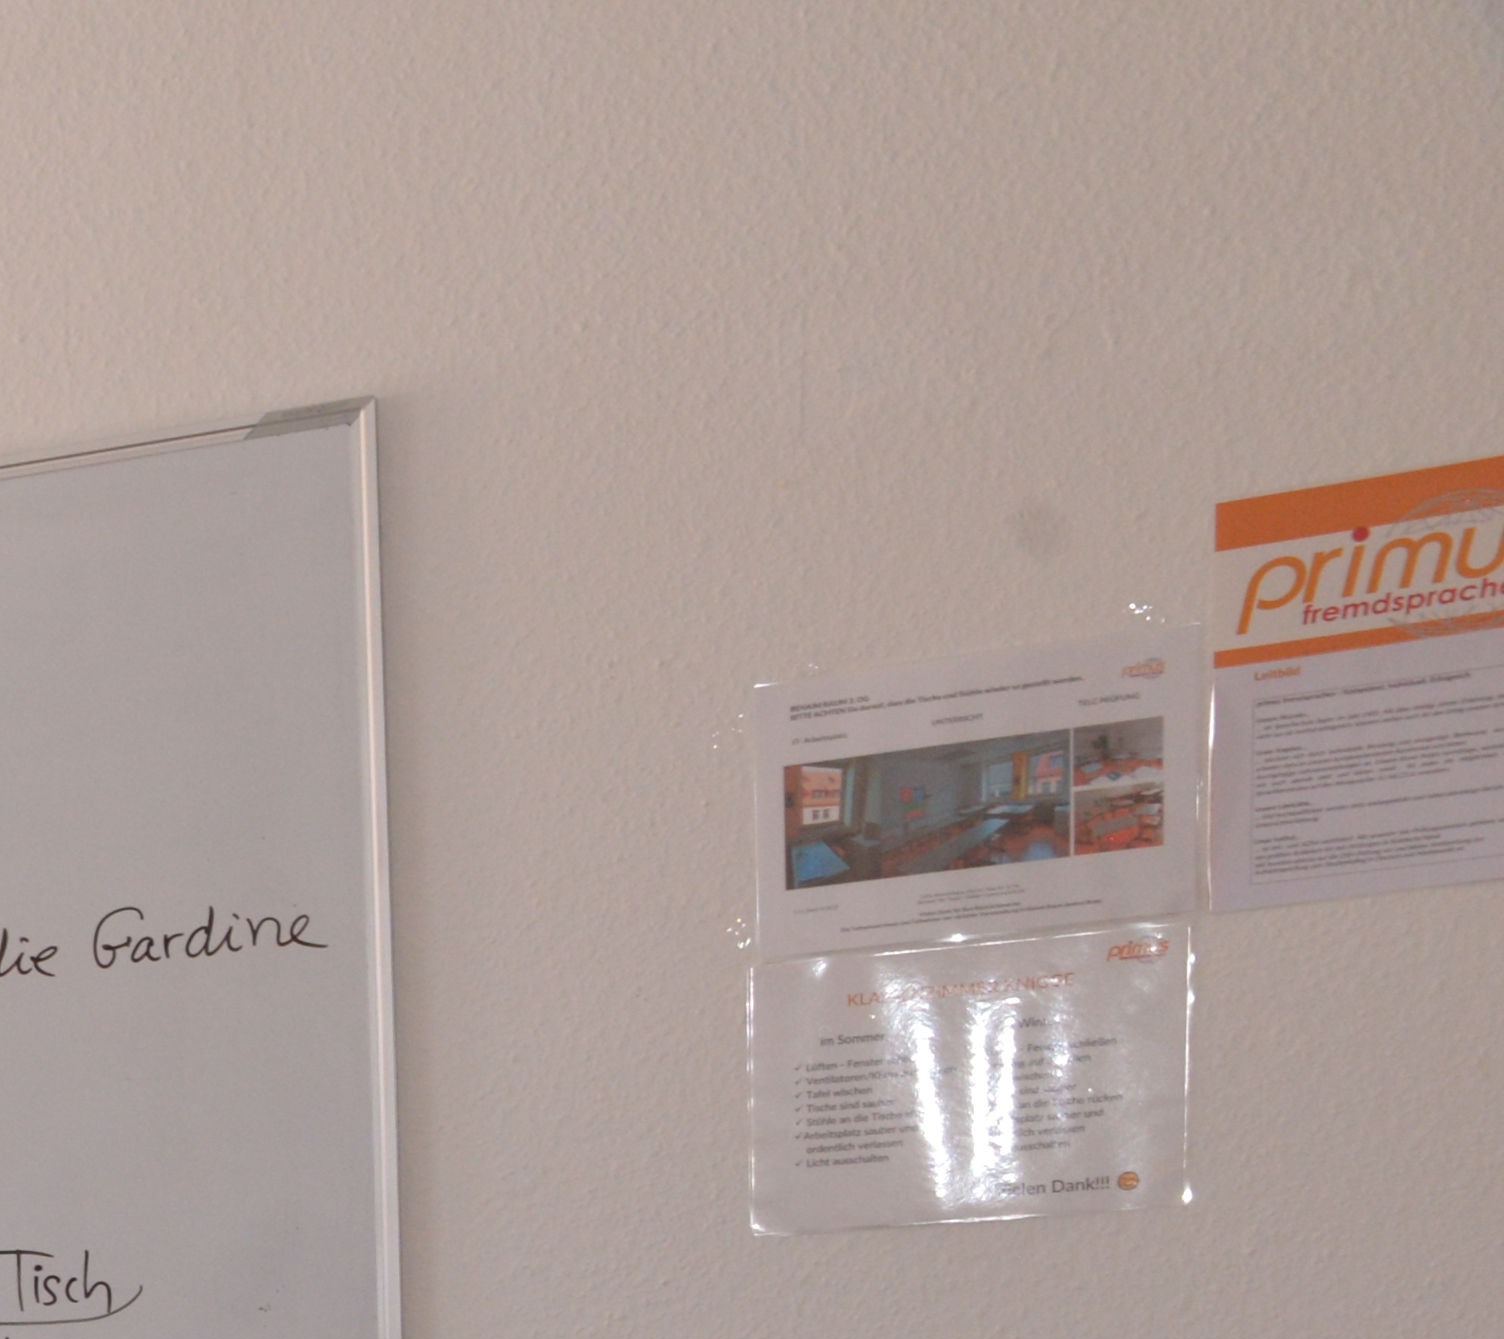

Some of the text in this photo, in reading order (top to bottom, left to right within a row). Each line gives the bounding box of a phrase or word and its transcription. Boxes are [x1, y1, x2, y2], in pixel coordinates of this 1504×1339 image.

[1236, 525, 1504, 635] primu
[1302, 578, 1504, 626] fremdsprach
[92, 905, 329, 970] Gardine
[837, 1033, 885, 1045] Sommer
[806, 1061, 838, 1072] Lüften
[846, 1057, 884, 1069] Fenster
[806, 1089, 831, 1099] Tafel
[806, 1103, 837, 1112] Tische
[806, 1157, 830, 1168] Licht
